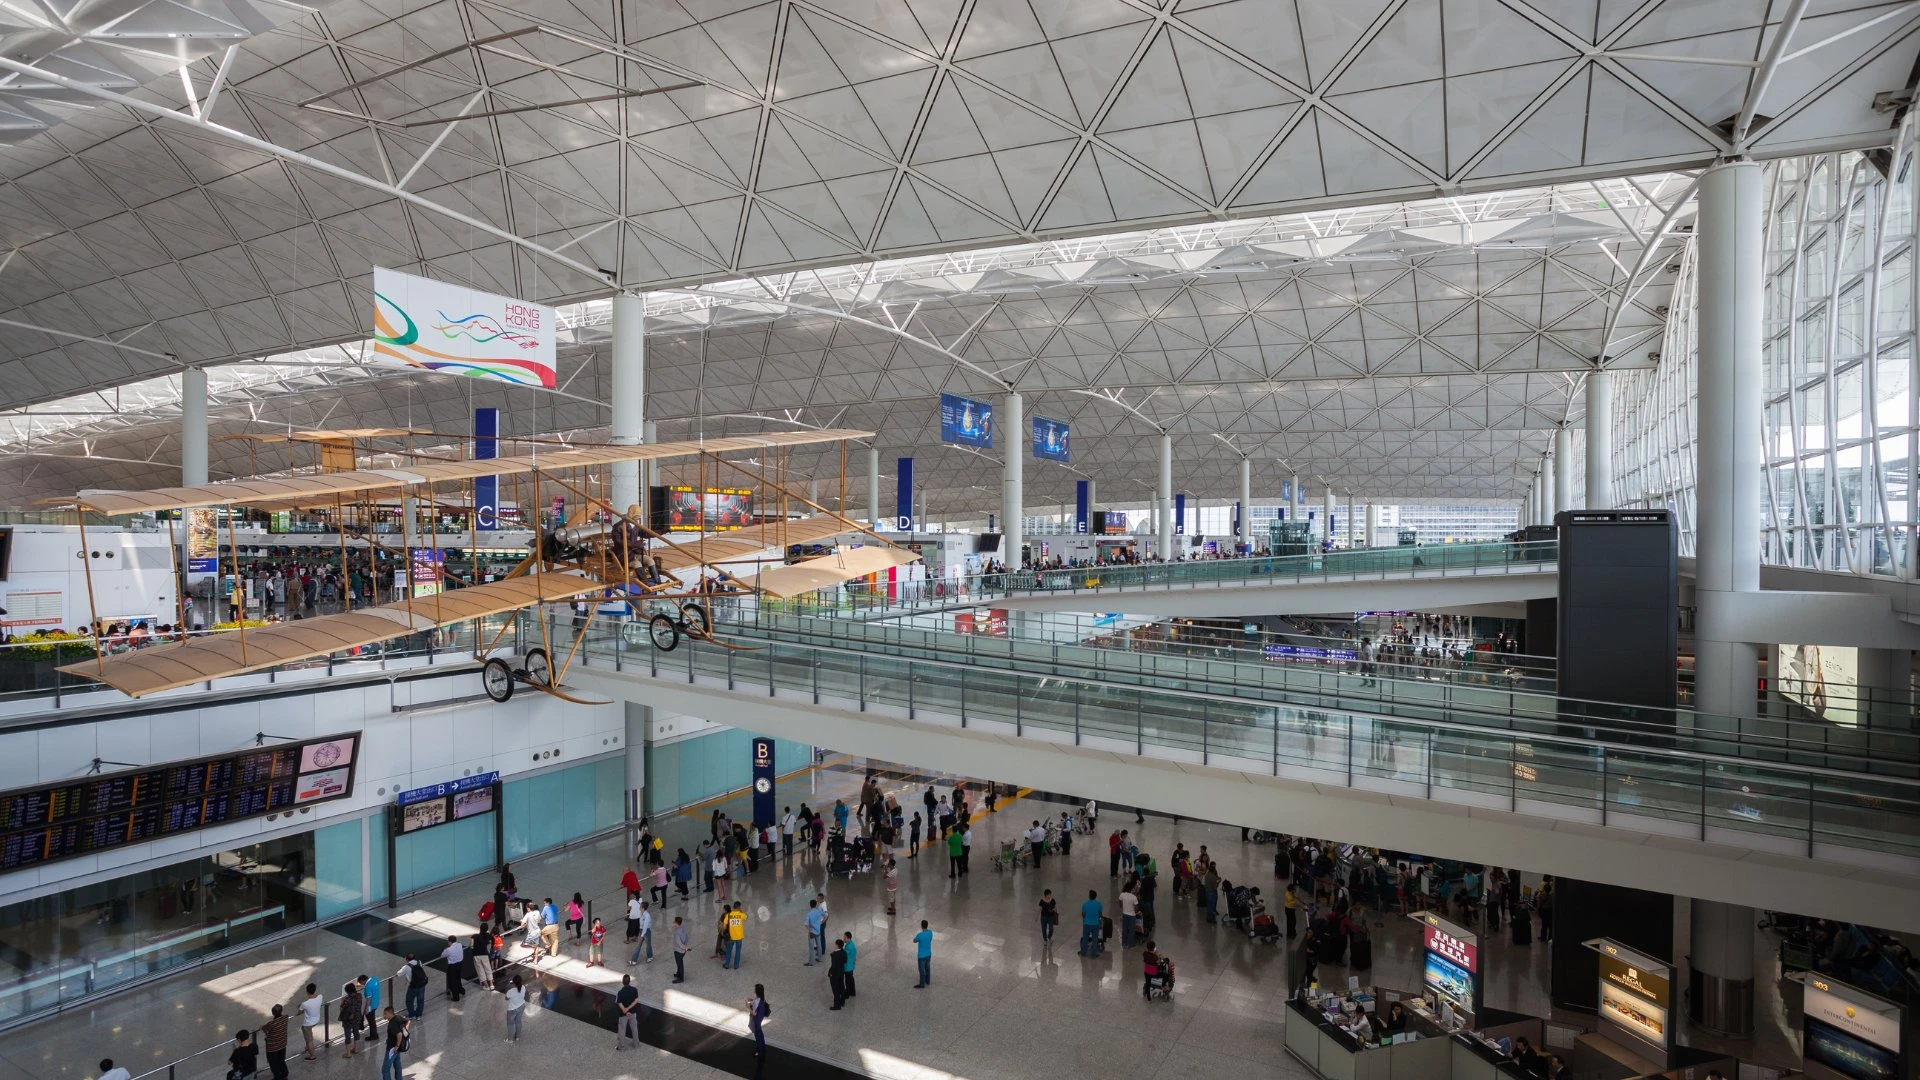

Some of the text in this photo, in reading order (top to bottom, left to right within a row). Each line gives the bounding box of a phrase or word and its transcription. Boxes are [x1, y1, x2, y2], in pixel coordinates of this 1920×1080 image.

[505, 303, 540, 319] HONG
[505, 314, 540, 329] KONG
[477, 505, 494, 527] C
[899, 516, 910, 529] D
[1078, 521, 1086, 532] E
[1176, 525, 1183, 534] F
[937, 541, 944, 550] D
[757, 742, 768, 759] B
[490, 772, 499, 783] A
[437, 784, 446, 795] B
[1622, 973, 1643, 988] REGAL
